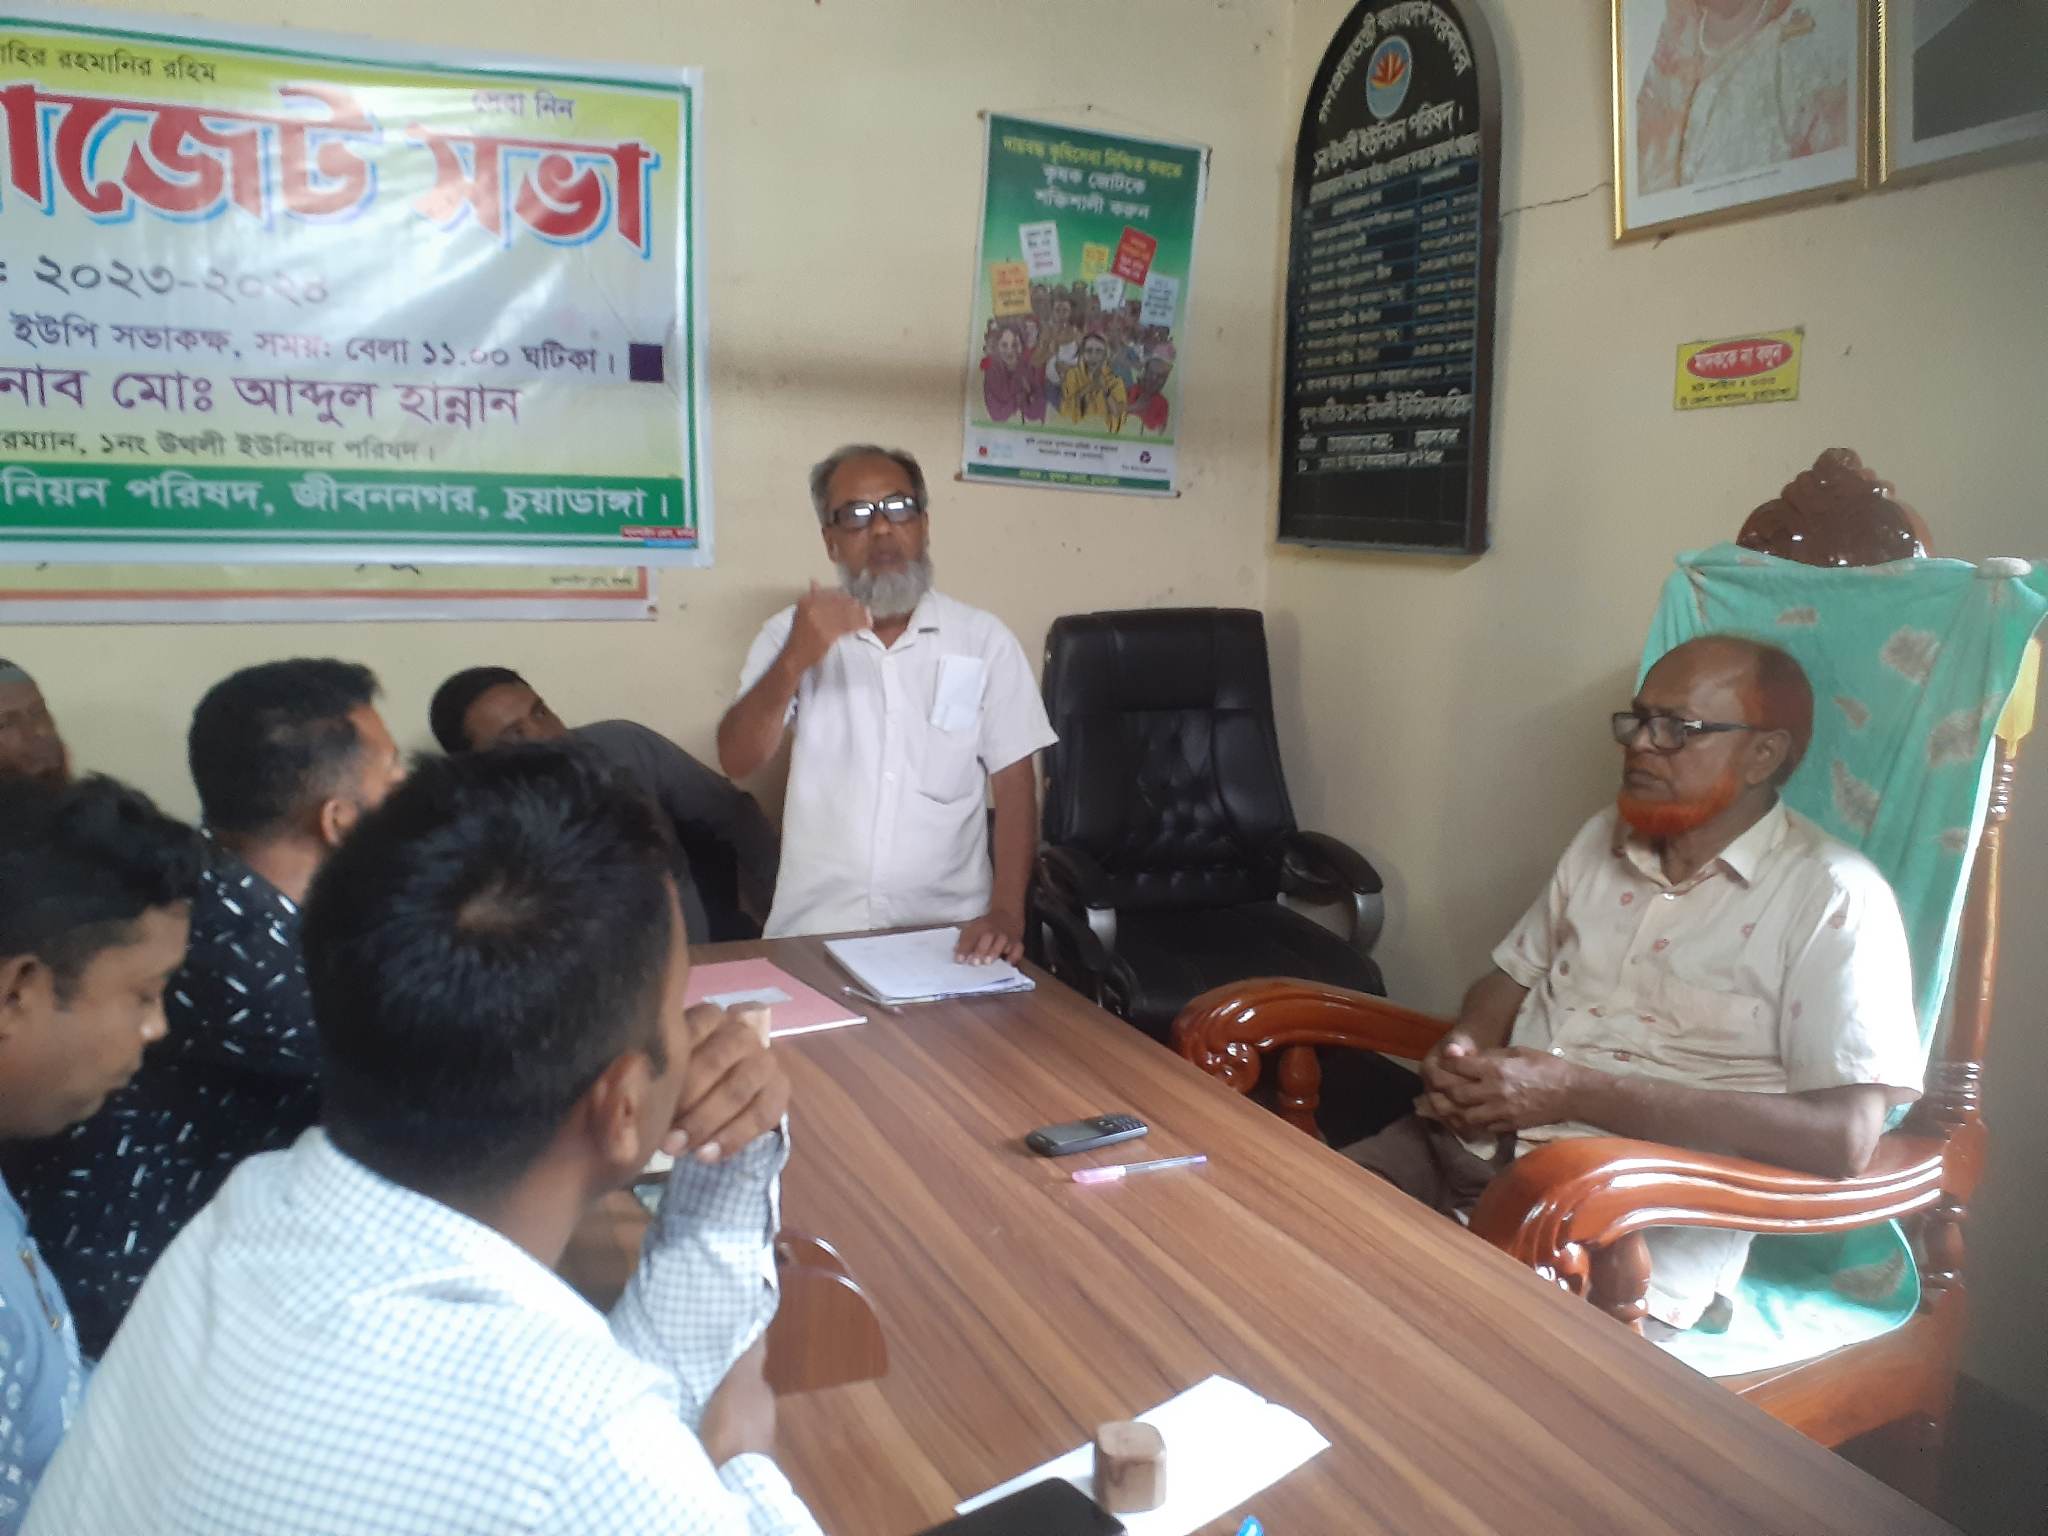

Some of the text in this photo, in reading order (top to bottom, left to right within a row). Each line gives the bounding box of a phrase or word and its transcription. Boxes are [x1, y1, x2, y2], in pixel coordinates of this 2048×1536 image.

[163, 54, 217, 83] রহিম
[0, 82, 658, 257] াজেট সভা
[10, 310, 100, 349] ইউপি
[345, 337, 408, 364] বেলা
[0, 363, 525, 430] নাব মোঃ আব্দুল হান্নান
[235, 431, 336, 458] ইউনিয়ন
[0, 466, 110, 509] নিয়ন
[125, 470, 275, 515] পরিষদ,
[289, 471, 490, 520] জীবননগর,
